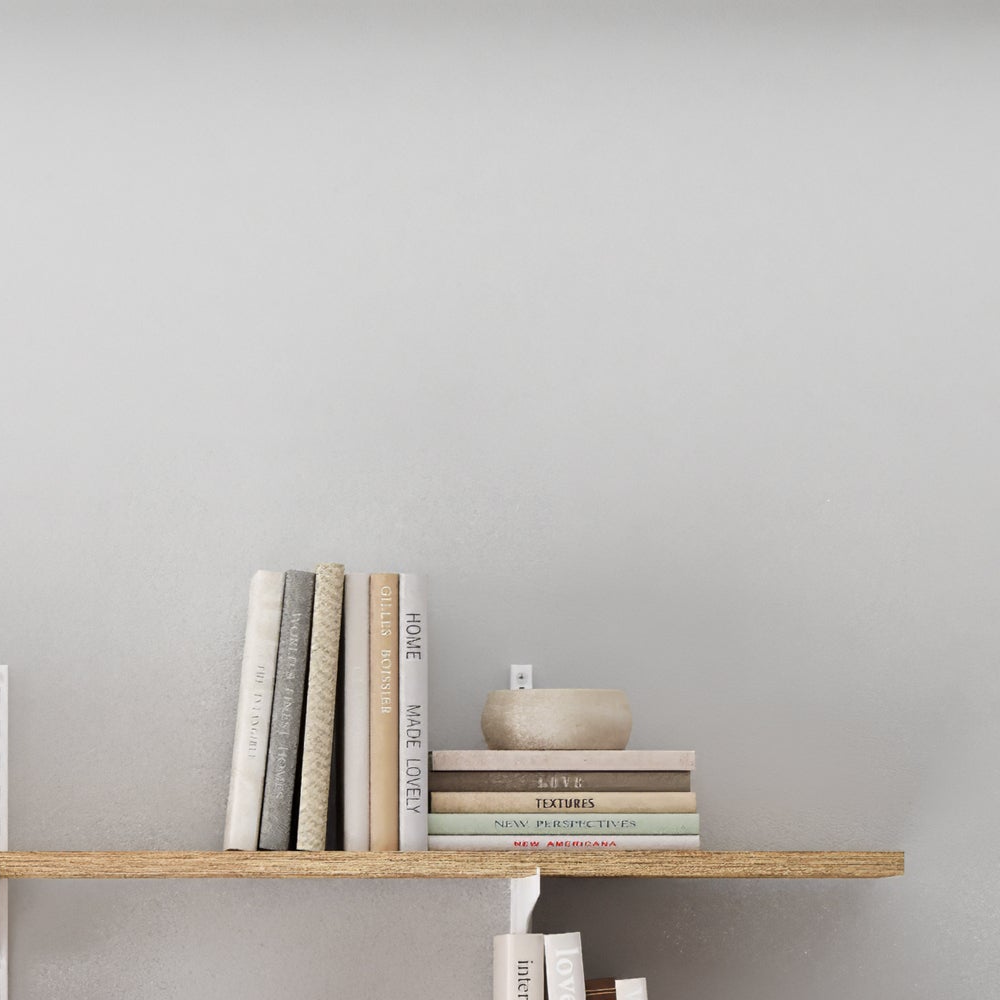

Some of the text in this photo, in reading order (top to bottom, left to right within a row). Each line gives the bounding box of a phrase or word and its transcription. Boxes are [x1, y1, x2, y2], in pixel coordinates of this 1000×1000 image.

[381, 586, 392, 714] GILLES BOISSIER
[406, 613, 421, 814] HOME MADE LOVELY
[274, 746, 287, 799] HOMES
[494, 820, 636, 828] NEW PERSPECTIVES
[535, 798, 595, 809] TEXTURES
